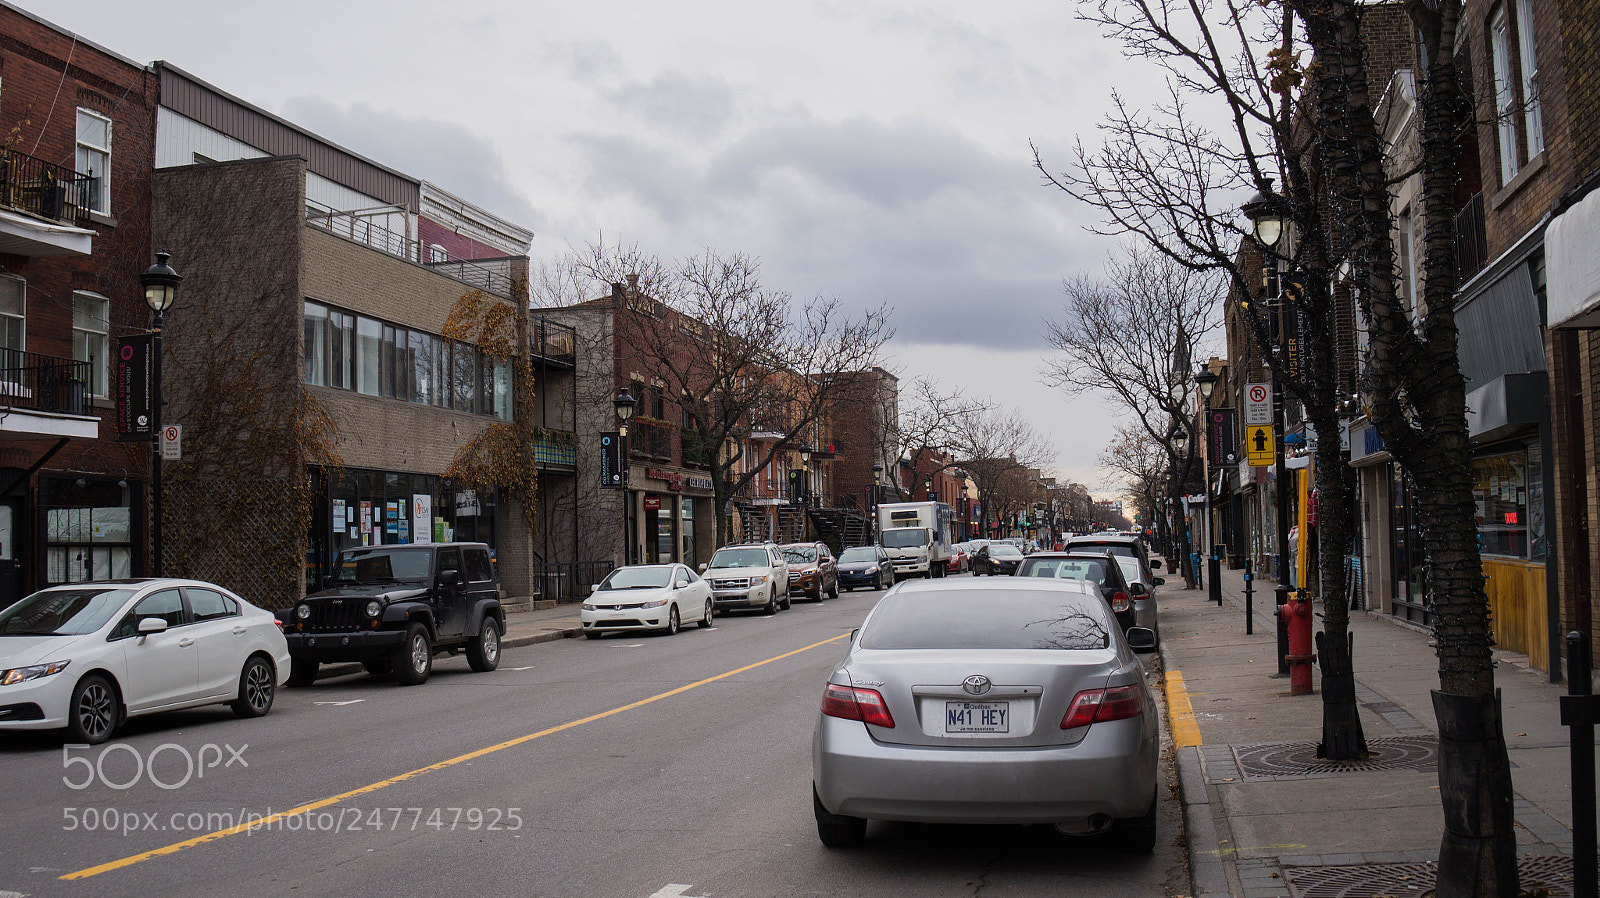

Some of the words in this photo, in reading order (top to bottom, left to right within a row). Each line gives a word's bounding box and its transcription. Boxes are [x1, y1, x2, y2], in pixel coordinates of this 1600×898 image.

[1296, 309, 1306, 368] NATURELLEMENT
[1288, 338, 1298, 377] VISITER
[126, 385, 131, 393] DE
[127, 423, 132, 433] ON
[949, 709, 972, 725] N41
[982, 709, 1006, 725] HEY
